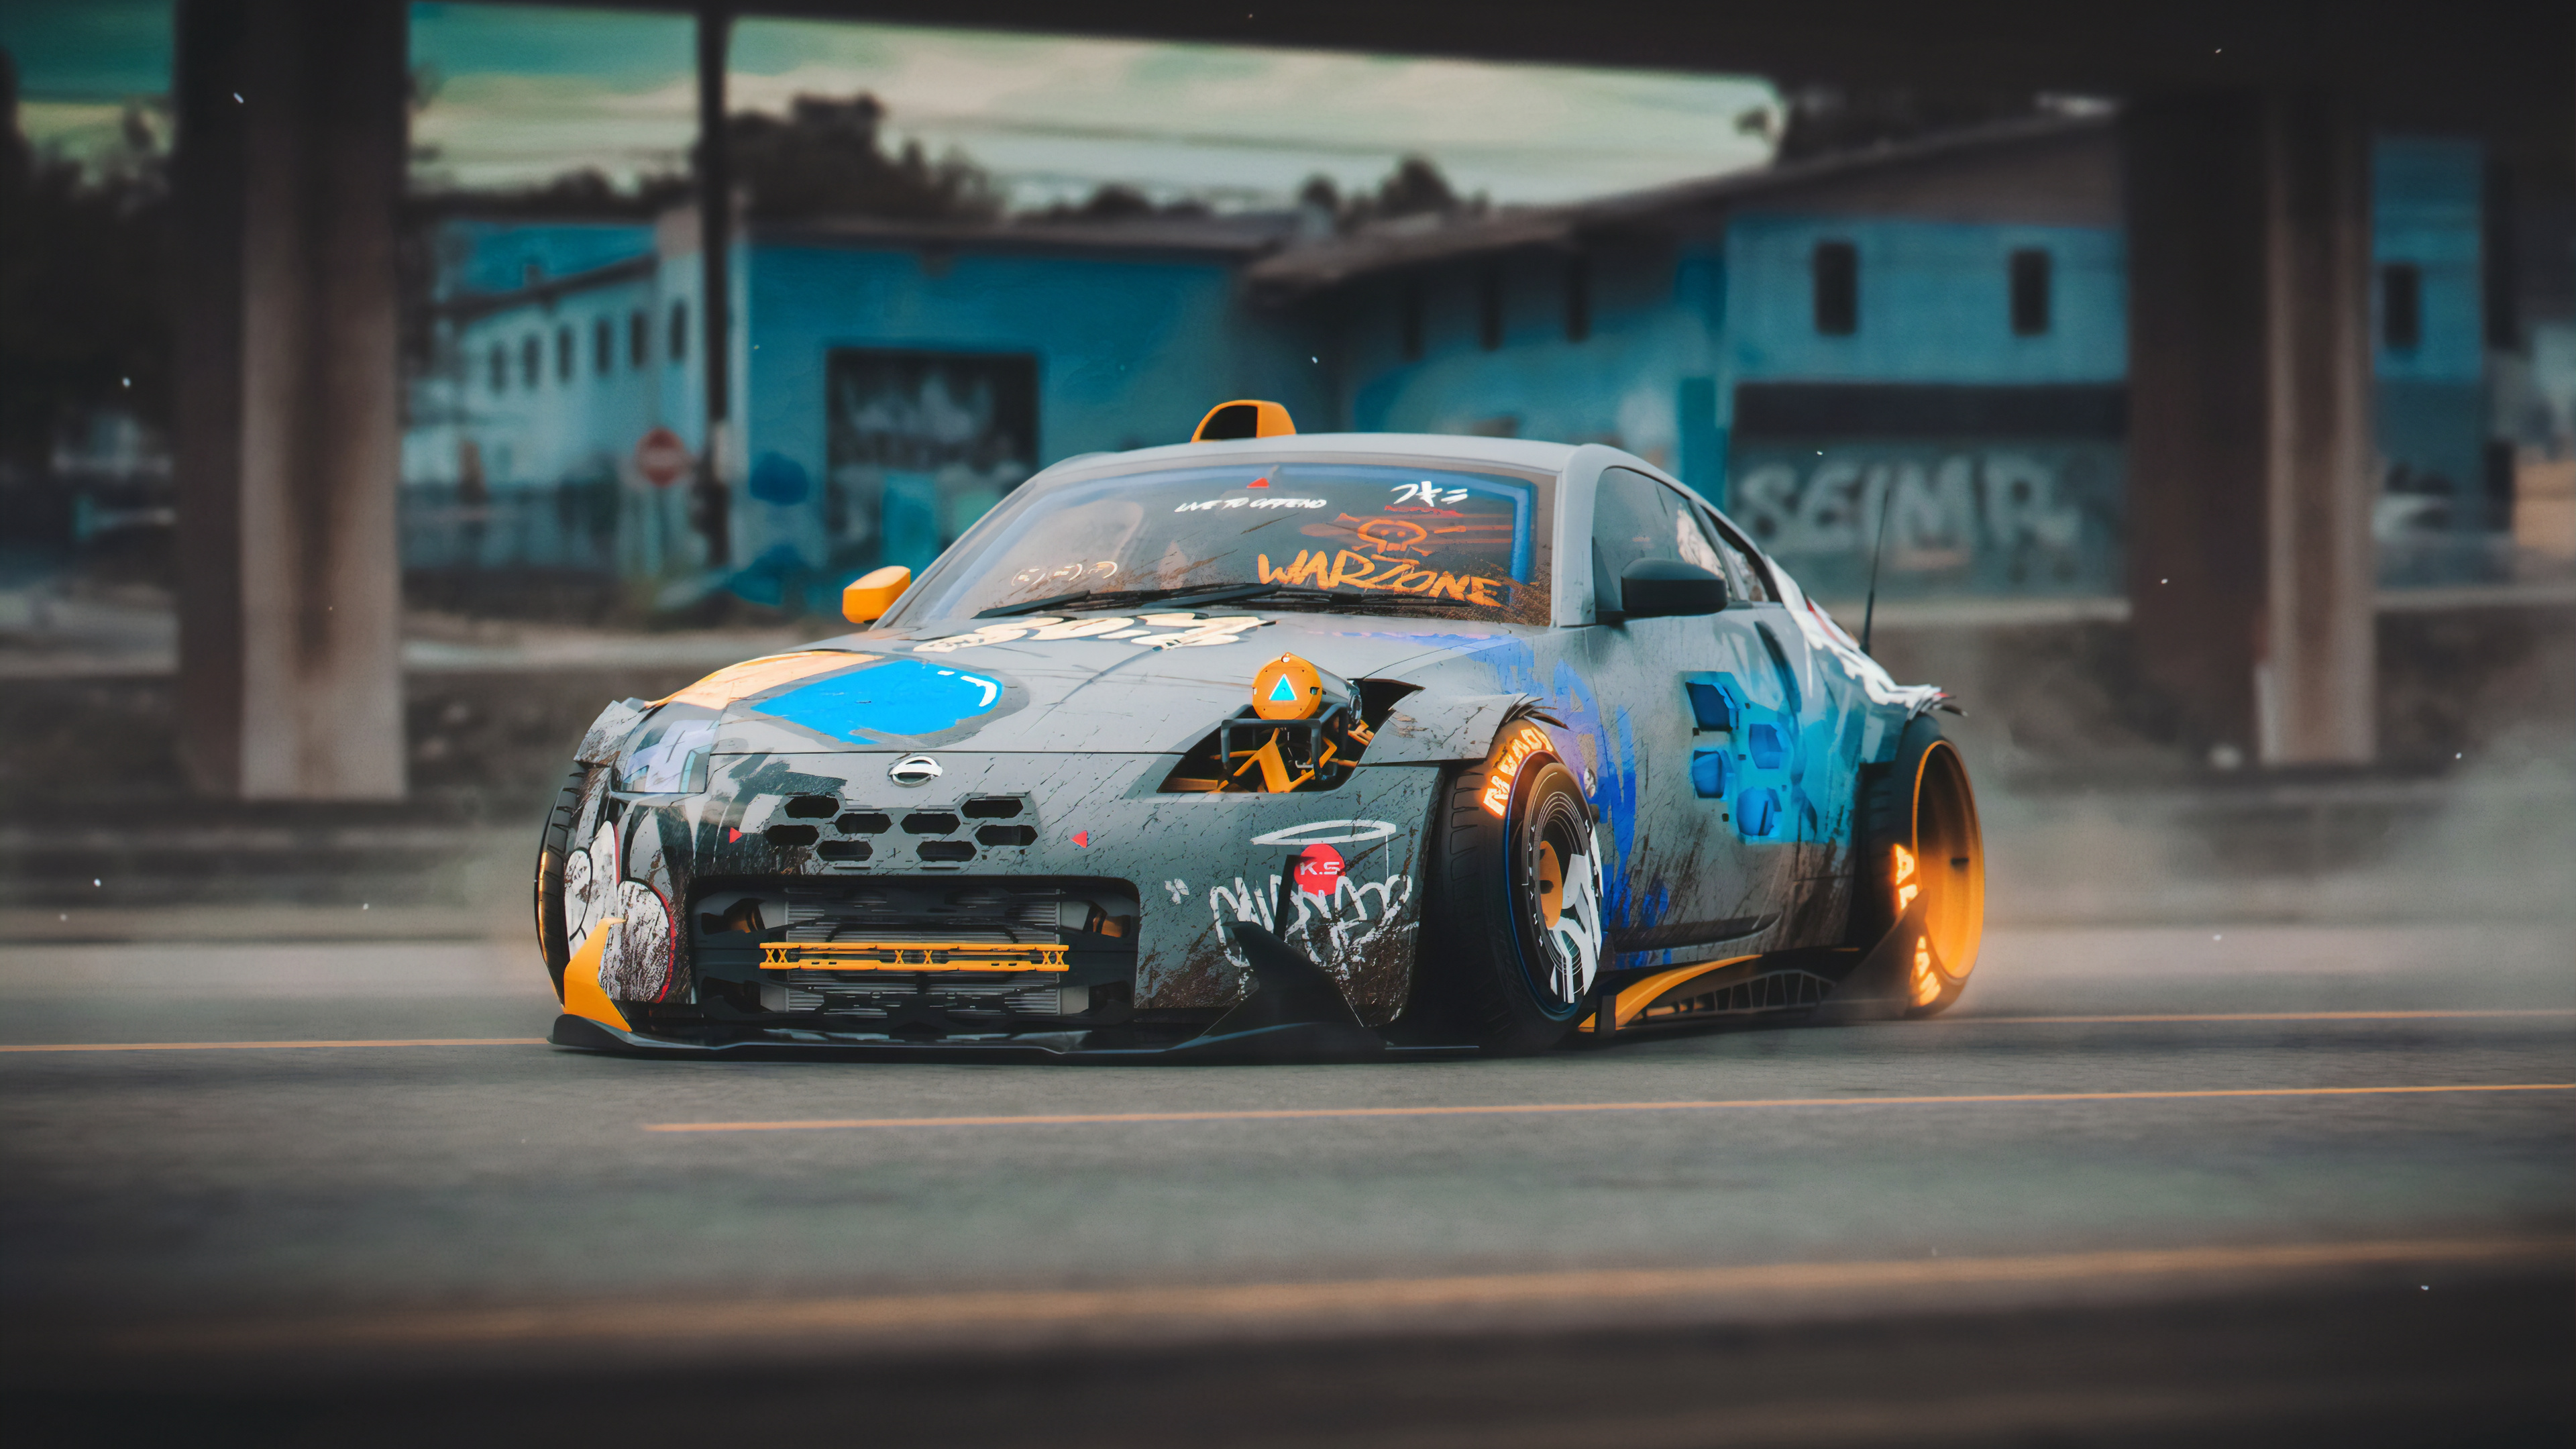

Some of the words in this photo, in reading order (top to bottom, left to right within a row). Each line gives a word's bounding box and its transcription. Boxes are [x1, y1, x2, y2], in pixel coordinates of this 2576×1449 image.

[1221, 496, 1250, 511] TO
[1257, 549, 1503, 608] WARZONE
[1299, 861, 1341, 875] K.S
